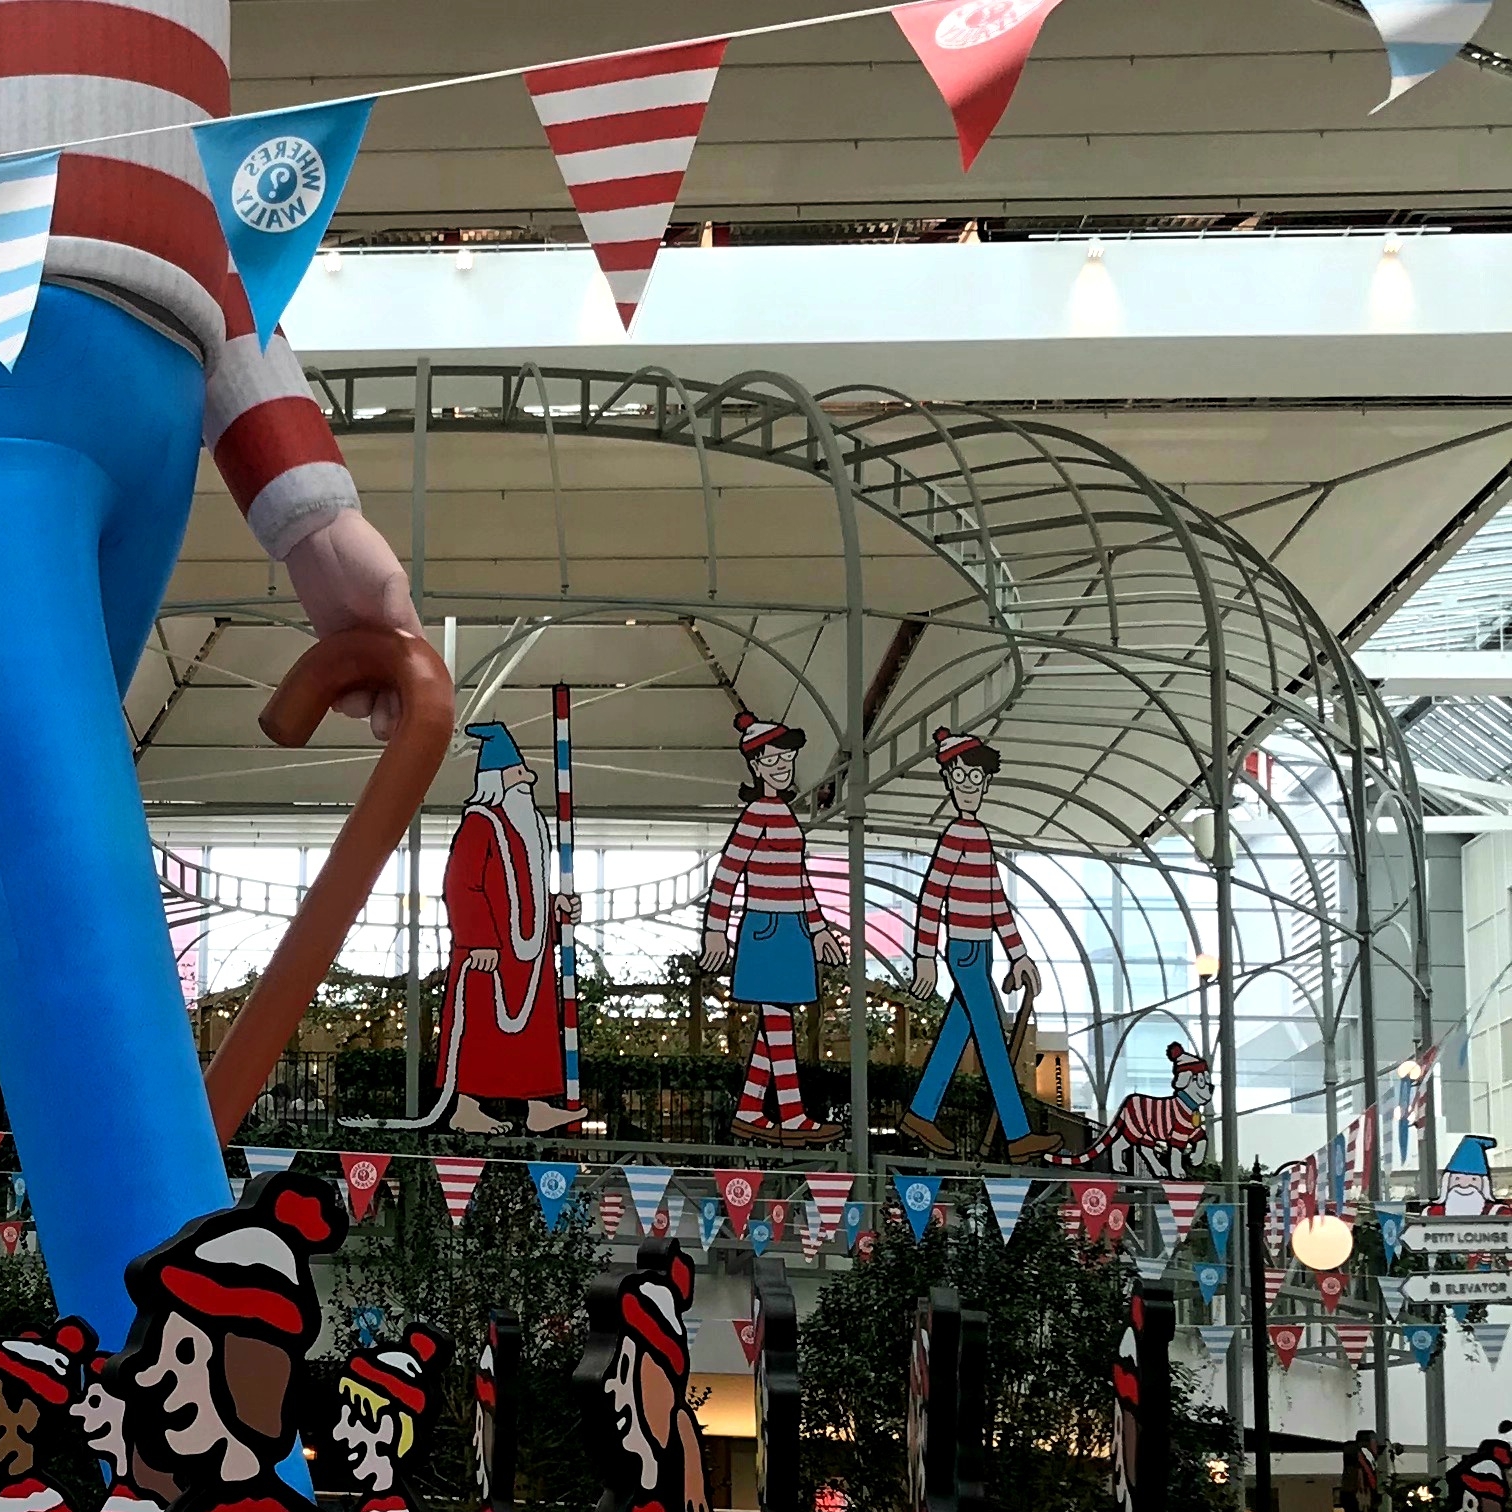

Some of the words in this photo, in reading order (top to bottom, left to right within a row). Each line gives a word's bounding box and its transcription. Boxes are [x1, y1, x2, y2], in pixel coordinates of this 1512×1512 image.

[1424, 1232, 1455, 1244] PETIT
[1457, 1231, 1509, 1244] LOUNGE
[1445, 1282, 1508, 1296] ELEVATOR
